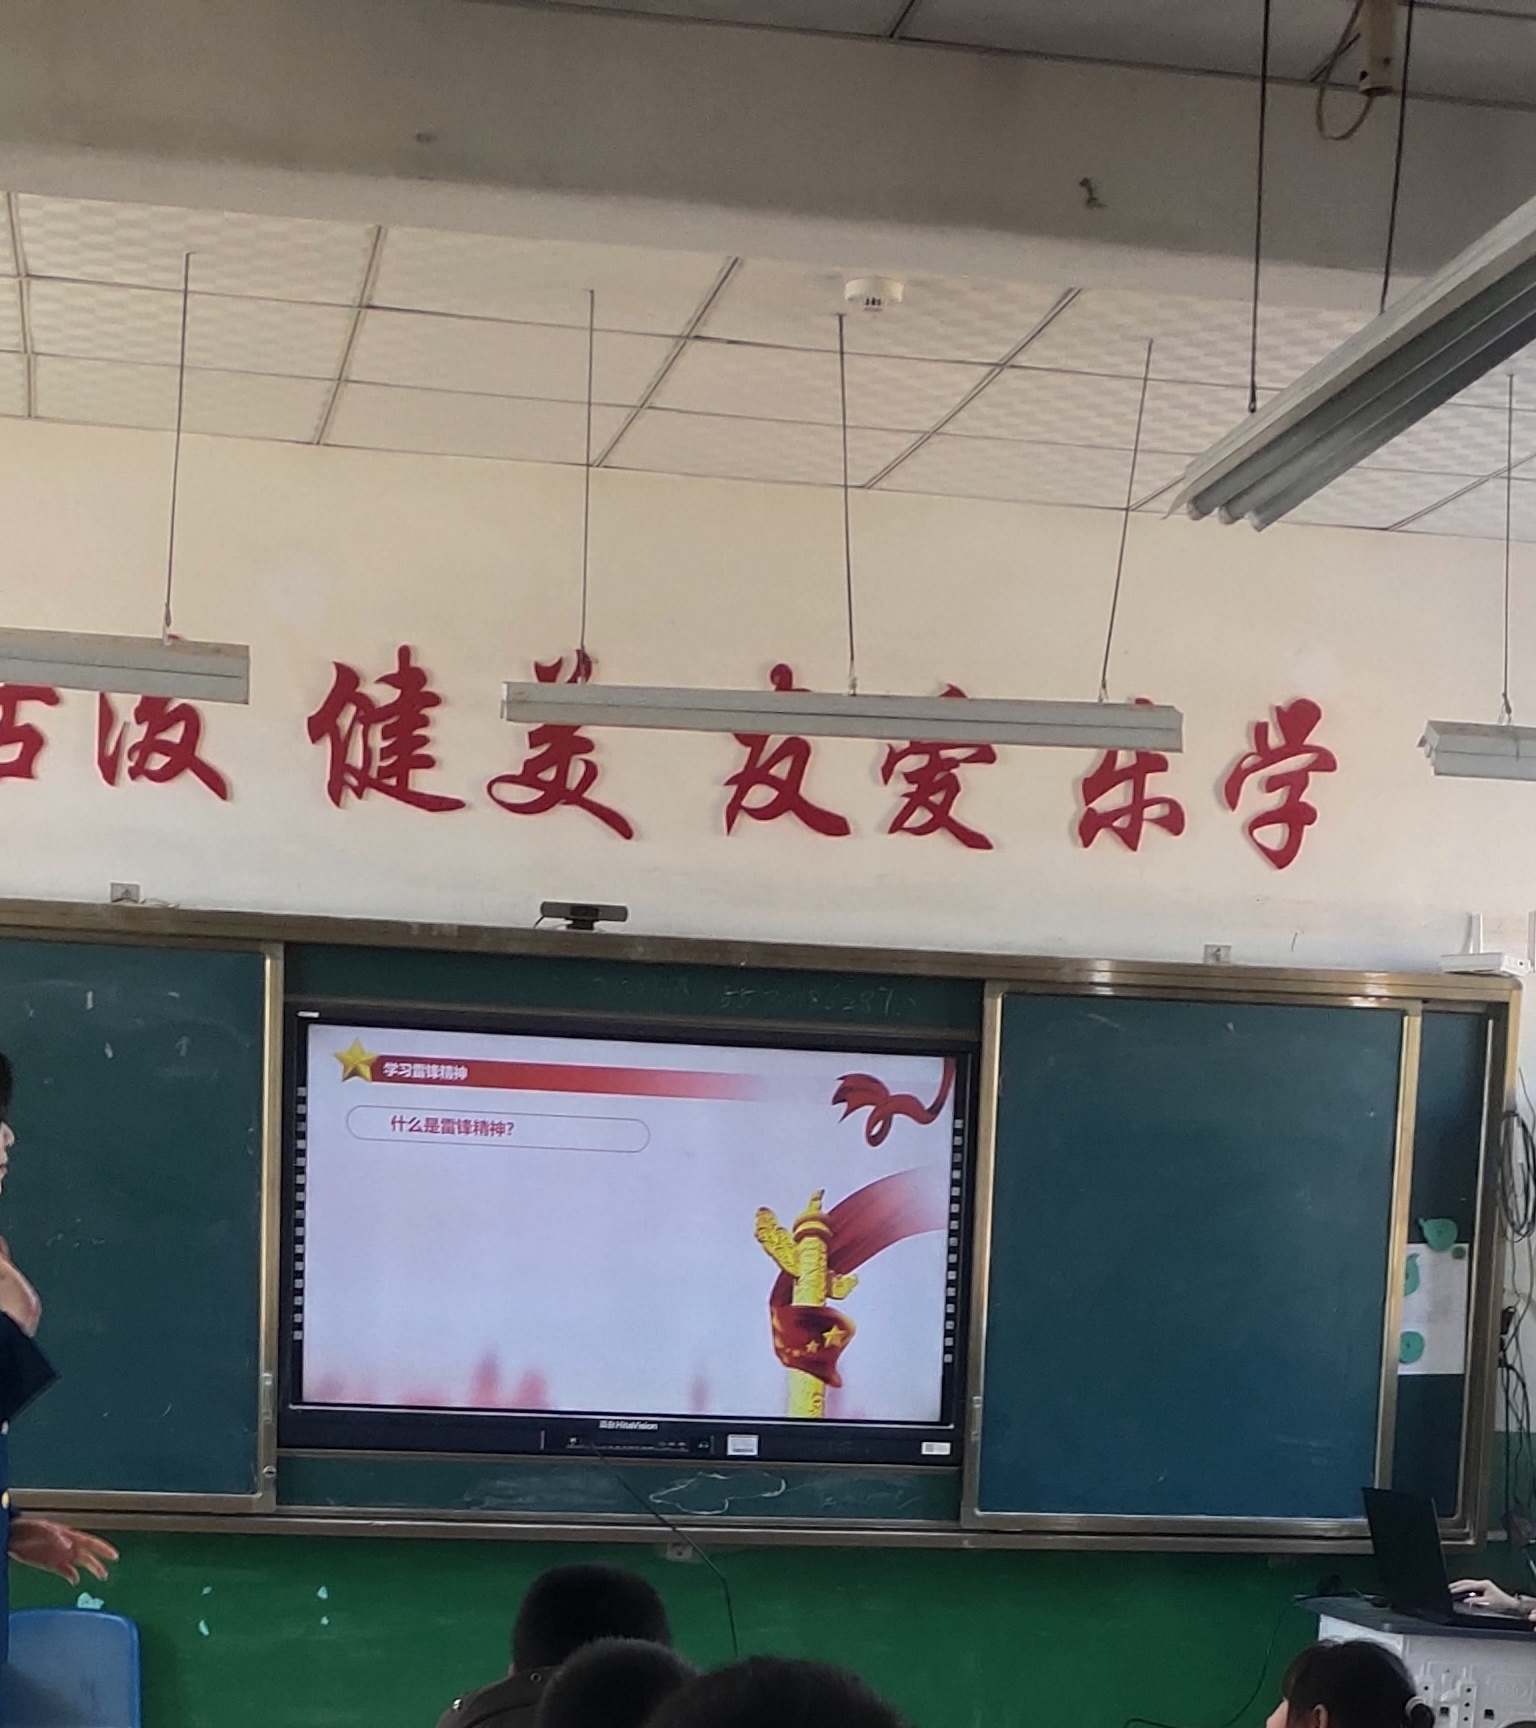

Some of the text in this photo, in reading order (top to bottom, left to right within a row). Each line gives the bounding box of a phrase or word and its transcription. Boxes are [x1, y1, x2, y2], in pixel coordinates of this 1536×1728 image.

[382, 1061, 469, 1081] 学习雷锋精神
